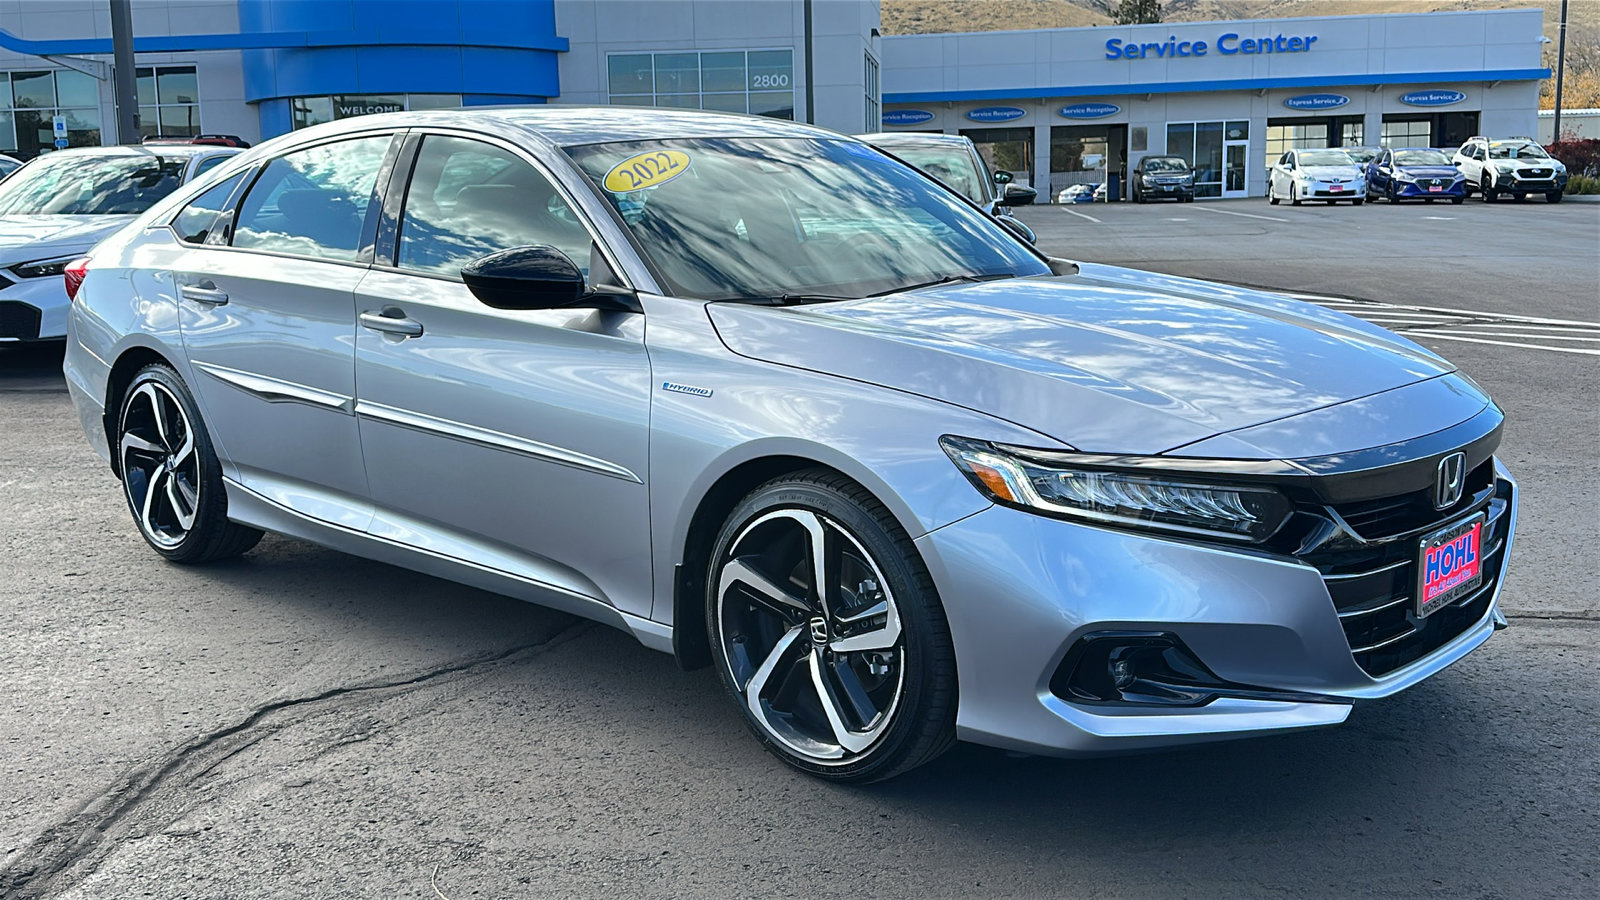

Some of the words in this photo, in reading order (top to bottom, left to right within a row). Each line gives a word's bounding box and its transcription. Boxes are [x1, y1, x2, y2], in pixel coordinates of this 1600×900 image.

[1105, 35, 1208, 59] Service
[1216, 32, 1318, 55] Center
[753, 74, 789, 87] 2800
[340, 105, 400, 115] WELCOME
[993, 109, 1023, 117] Reception
[1086, 106, 1117, 114] Reception
[620, 153, 679, 188] 2022
[669, 384, 709, 395] HYBRID
[1426, 534, 1475, 584] HOHL
